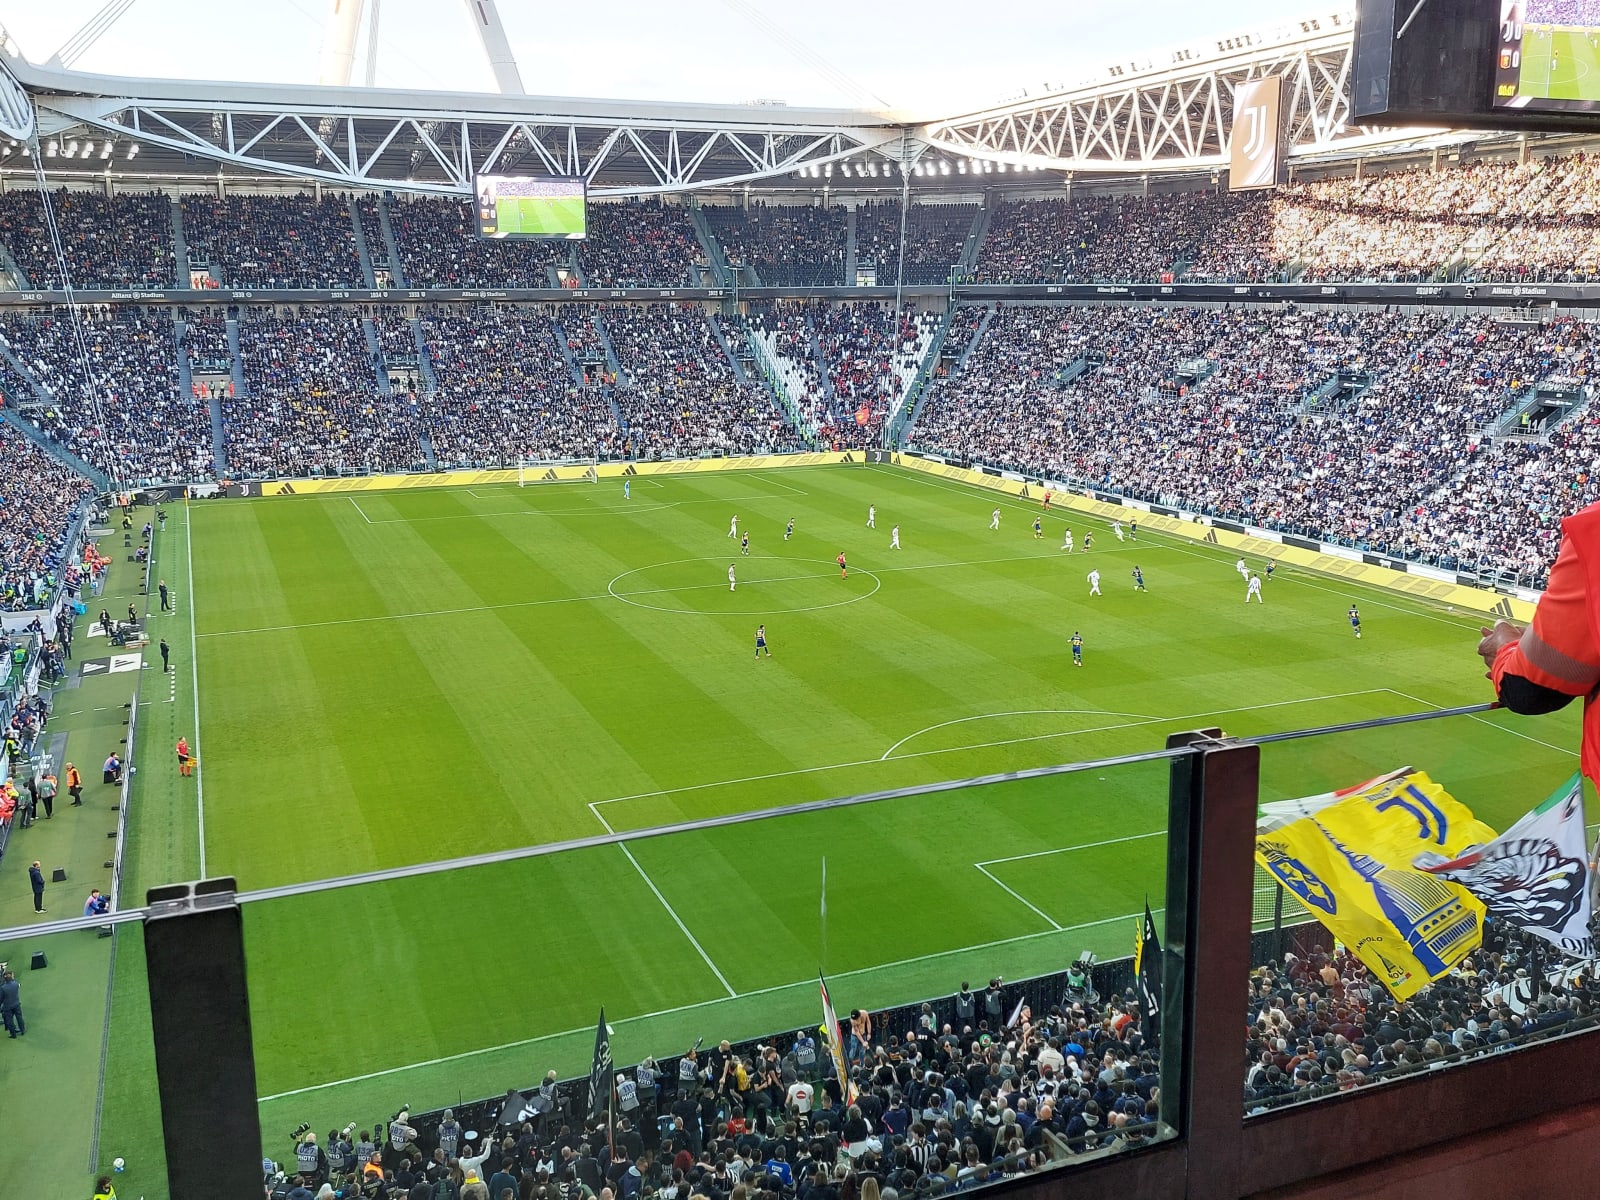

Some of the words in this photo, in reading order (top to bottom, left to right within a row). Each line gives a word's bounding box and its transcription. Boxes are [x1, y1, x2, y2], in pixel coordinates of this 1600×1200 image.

[1511, 50, 1520, 68] 0
[140, 291, 165, 299] Stadium
[1491, 287, 1513, 295] Allianz
[1521, 287, 1547, 295] Stadium
